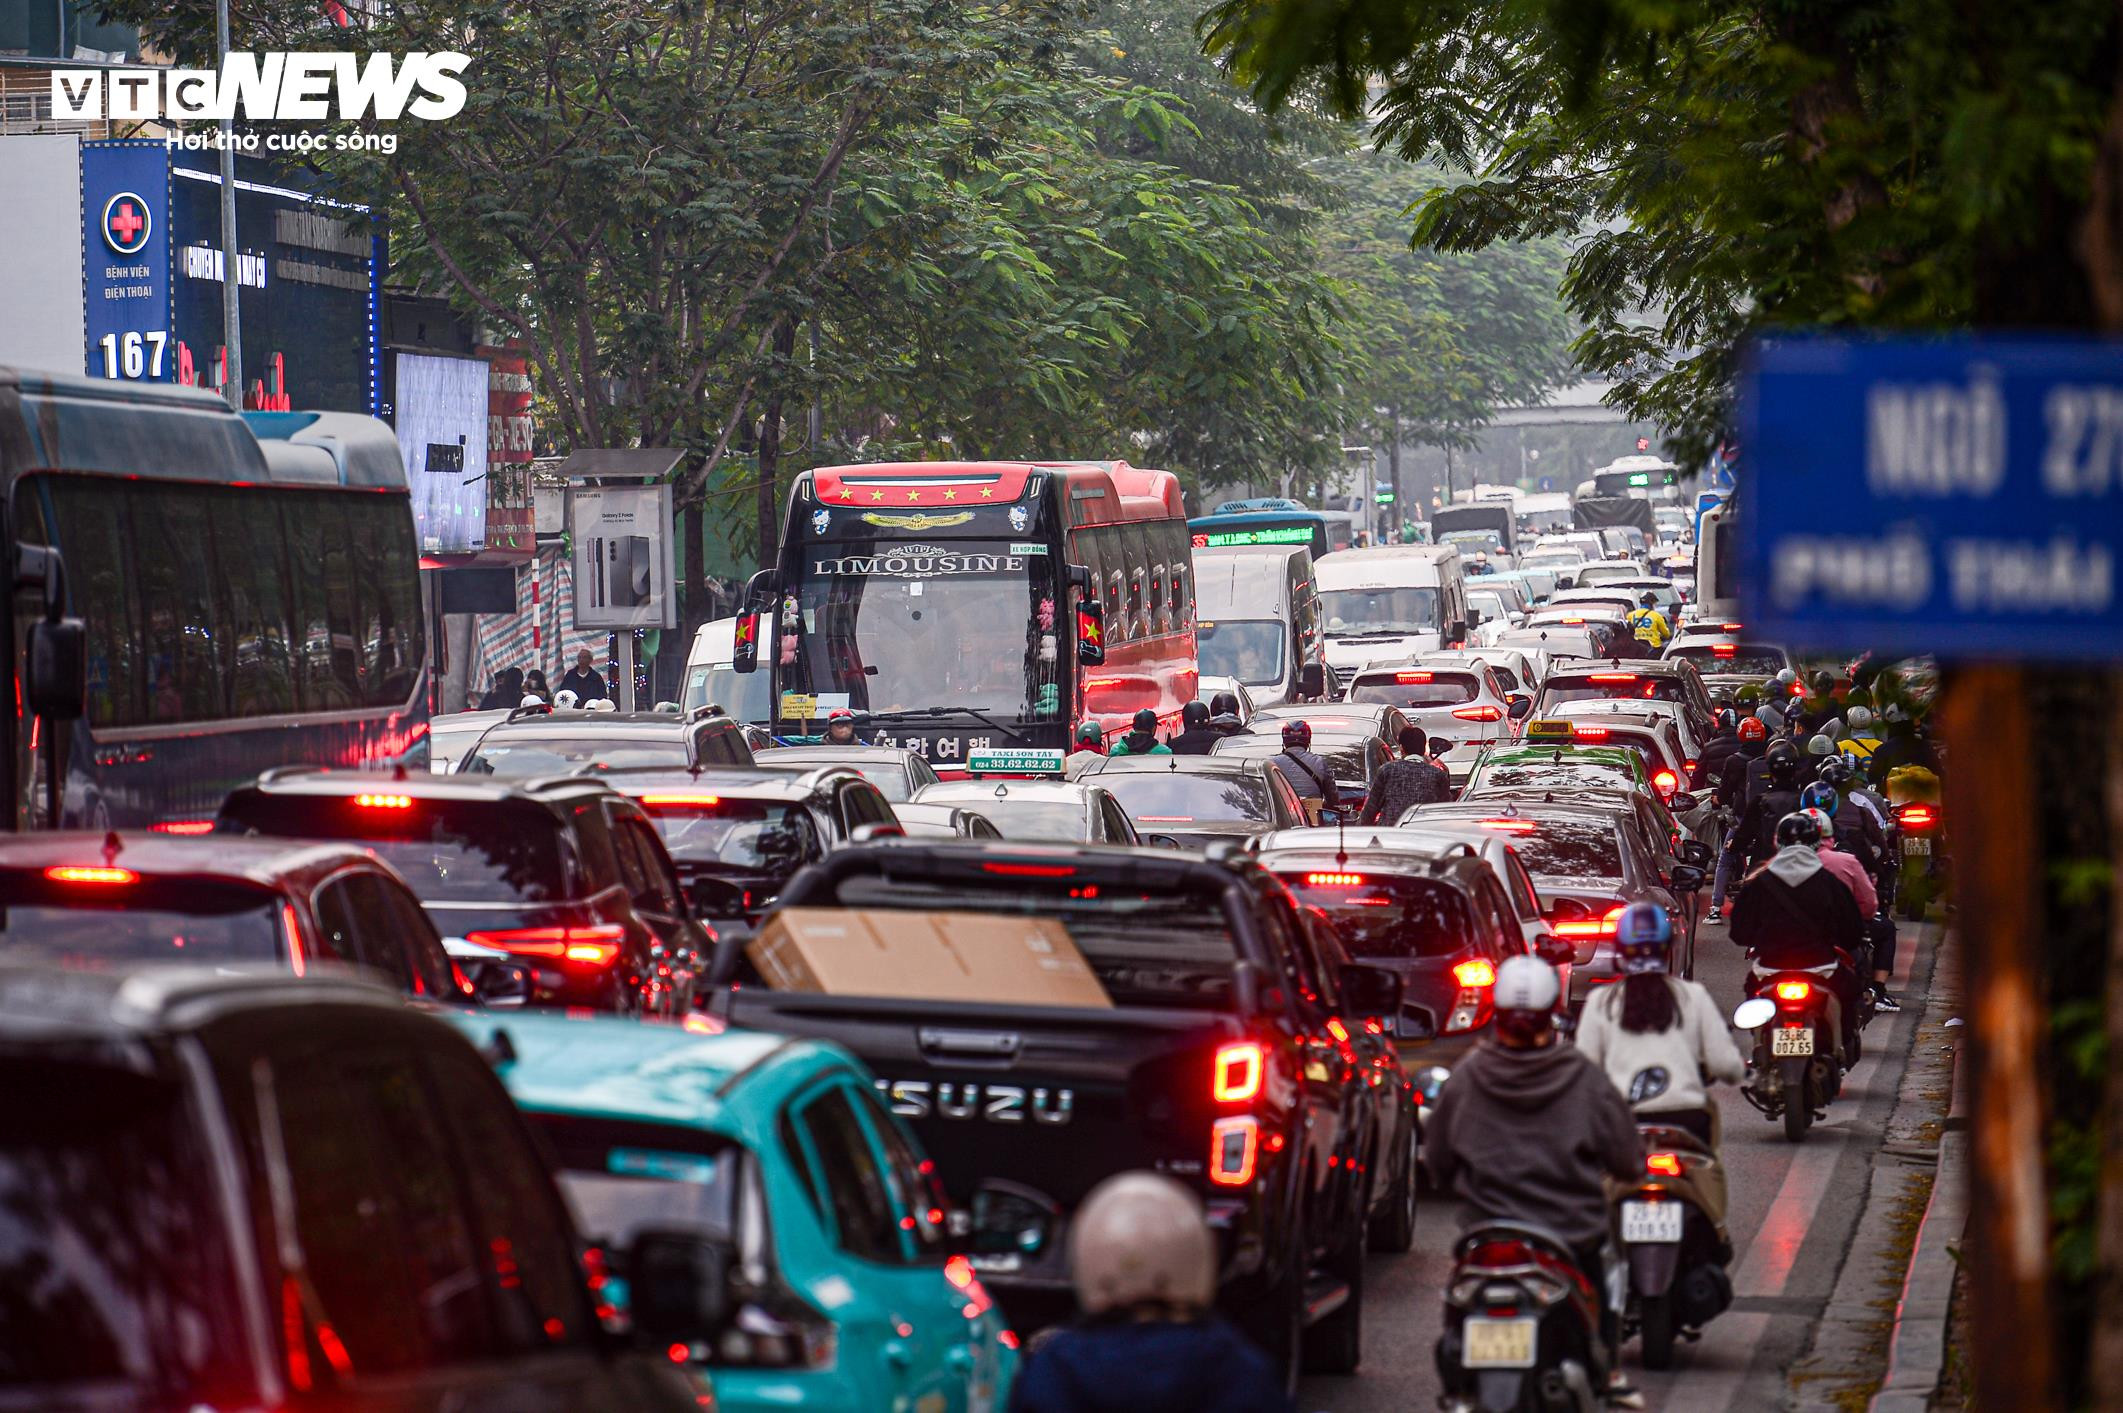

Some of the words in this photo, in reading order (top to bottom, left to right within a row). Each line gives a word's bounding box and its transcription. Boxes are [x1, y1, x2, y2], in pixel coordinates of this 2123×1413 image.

[106, 265, 128, 280] BỆNH
[130, 264, 150, 280] VIỆN
[105, 284, 126, 300] ĐIỆN
[127, 285, 152, 300] THOẠI
[101, 330, 167, 379] 167
[2043, 384, 2123, 494] 27
[903, 546, 931, 556] VIP
[814, 556, 1024, 575] LIMOUSINE
[991, 759, 1056, 769] 33.62.62.62
